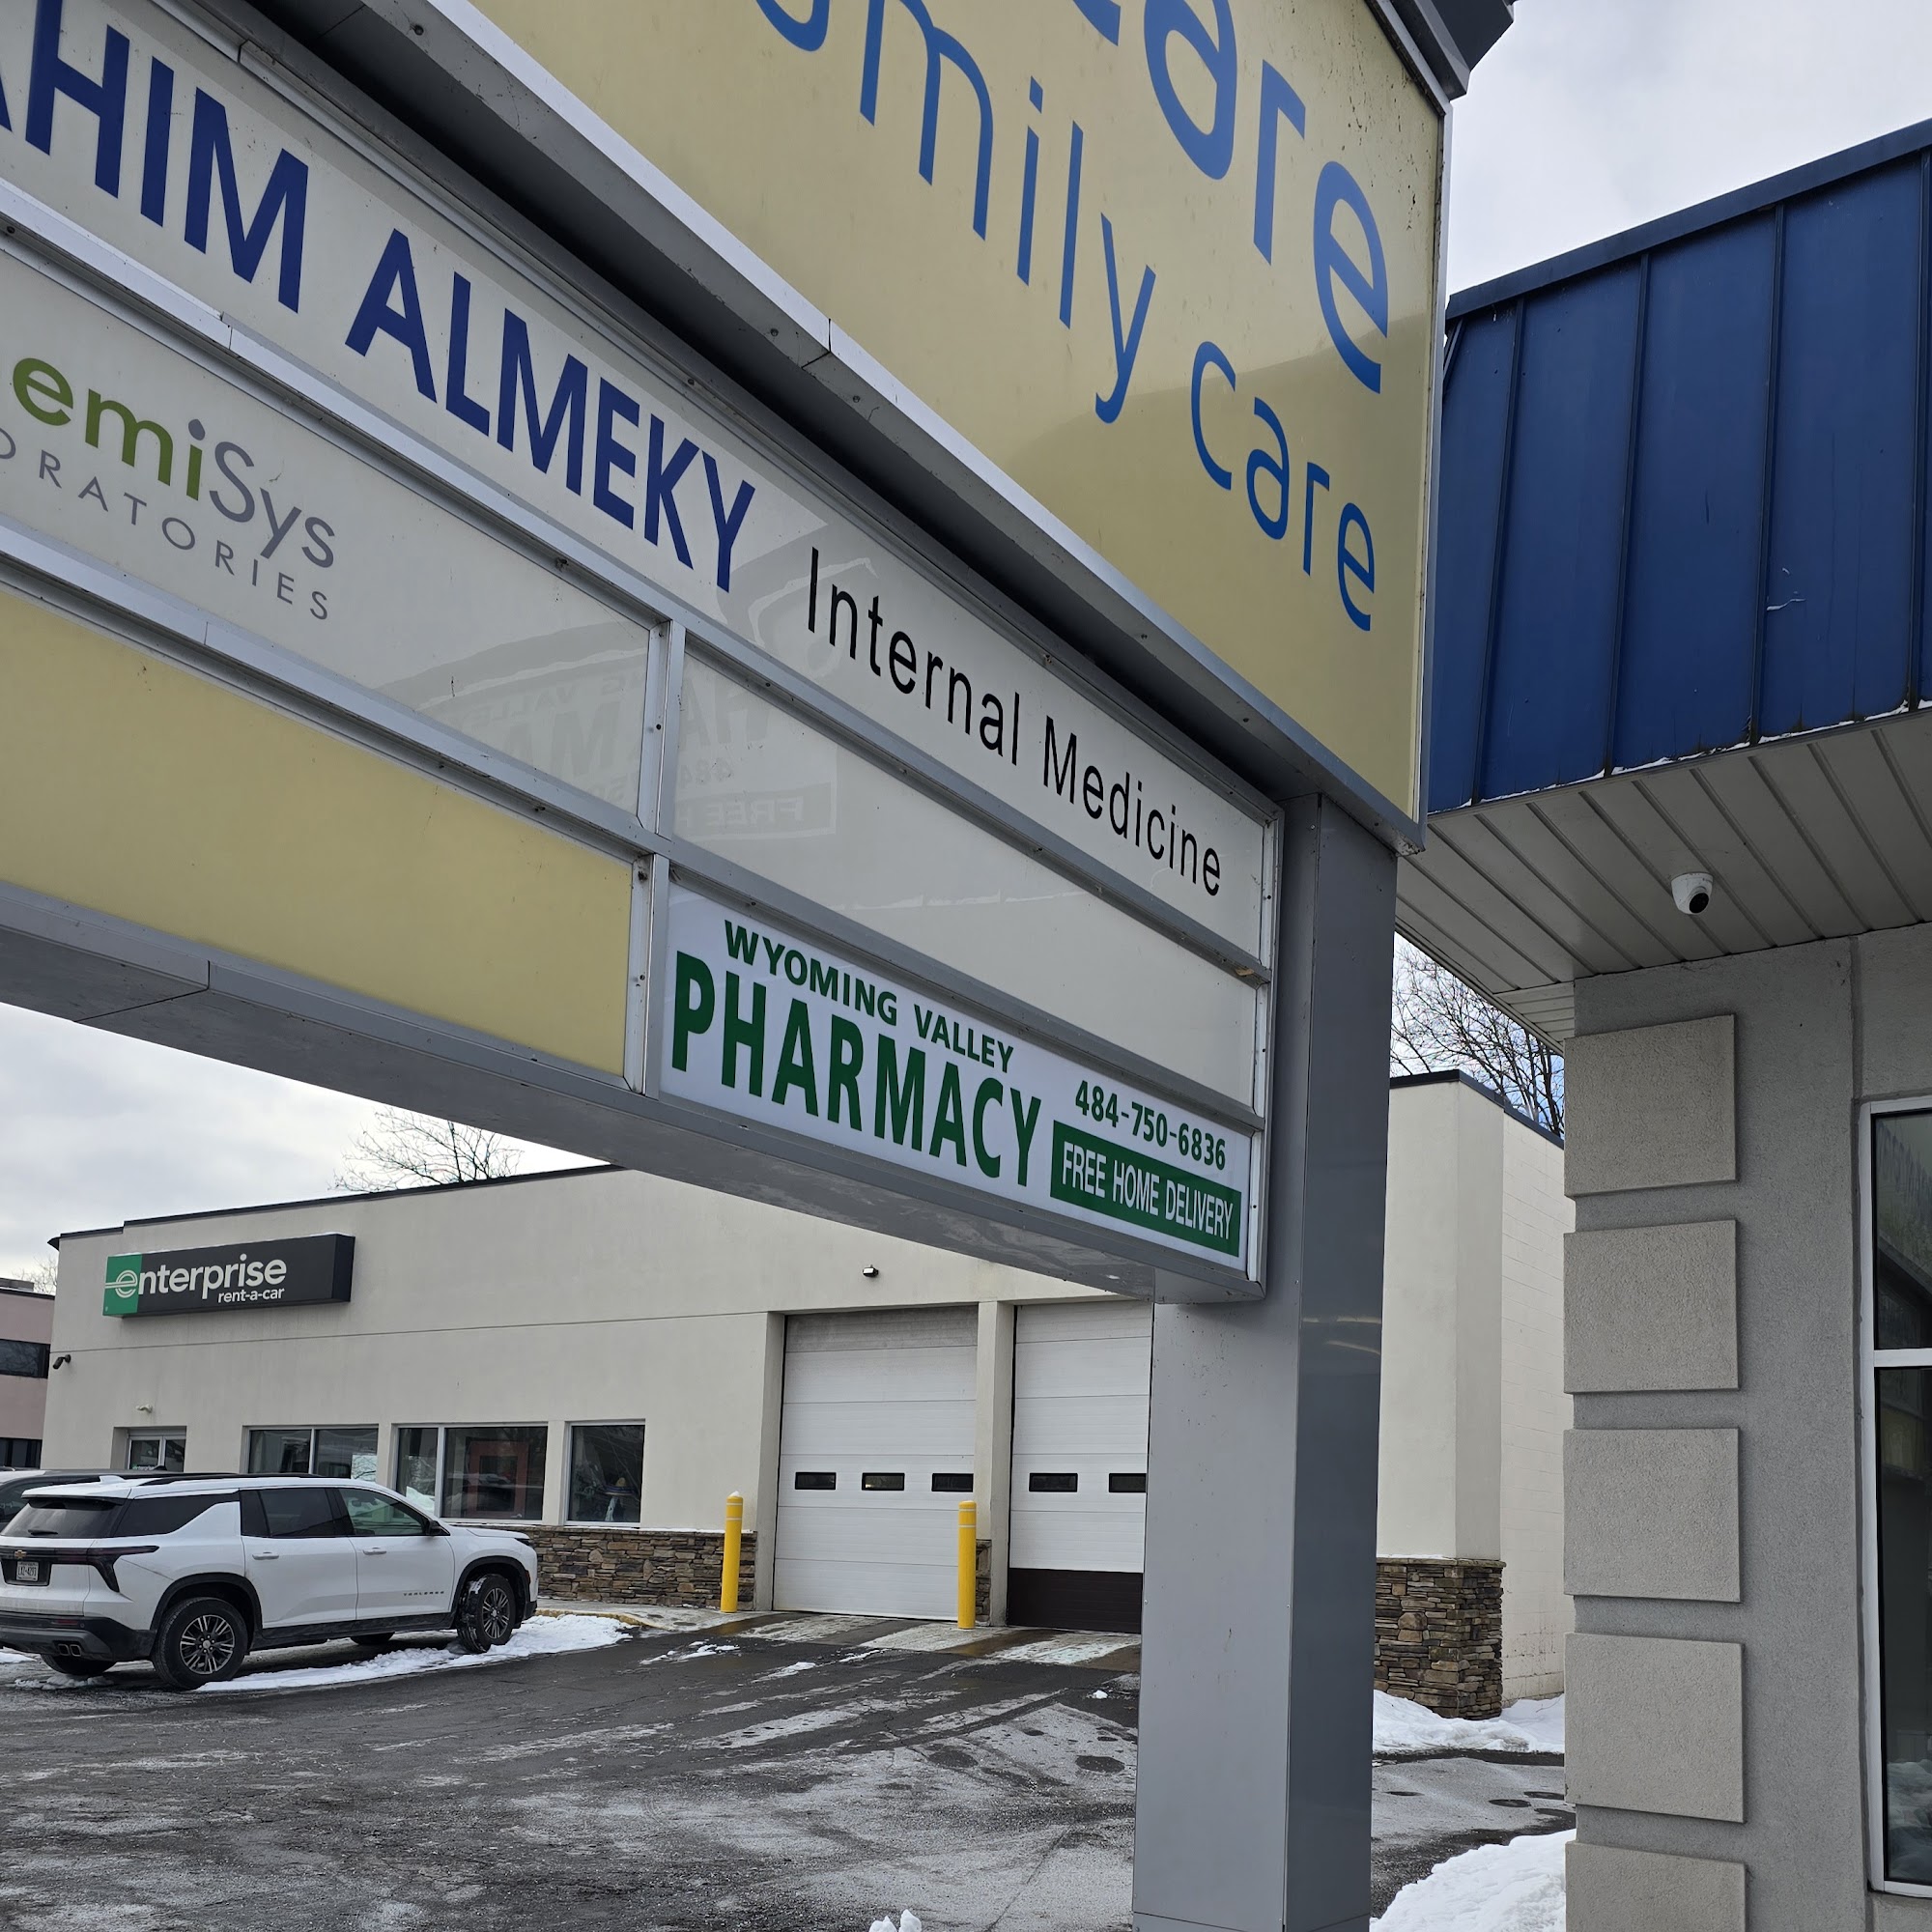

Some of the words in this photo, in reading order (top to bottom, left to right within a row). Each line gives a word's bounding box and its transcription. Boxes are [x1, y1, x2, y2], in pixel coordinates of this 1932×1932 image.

[1079, 0, 1388, 394] are
[756, 0, 1156, 423] mily
[1191, 341, 1375, 632] care
[0, 0, 308, 313] HIM
[345, 228, 755, 592] ALMEKY
[809, 547, 1020, 766] Internal
[1043, 715, 1220, 896] Medicine
[671, 951, 1041, 1187] PHARMACY
[724, 920, 897, 1026] WYOMING
[914, 1004, 1014, 1073] VALLEY
[1063, 1141, 1107, 1198] FREE
[1113, 1159, 1159, 1216] HOME
[1165, 1179, 1234, 1239] DELIVERY
[1075, 1080, 1226, 1171] 484-750-6836
[105, 1253, 287, 1299] enterprise
[217, 1287, 285, 1303] rent-a-car
